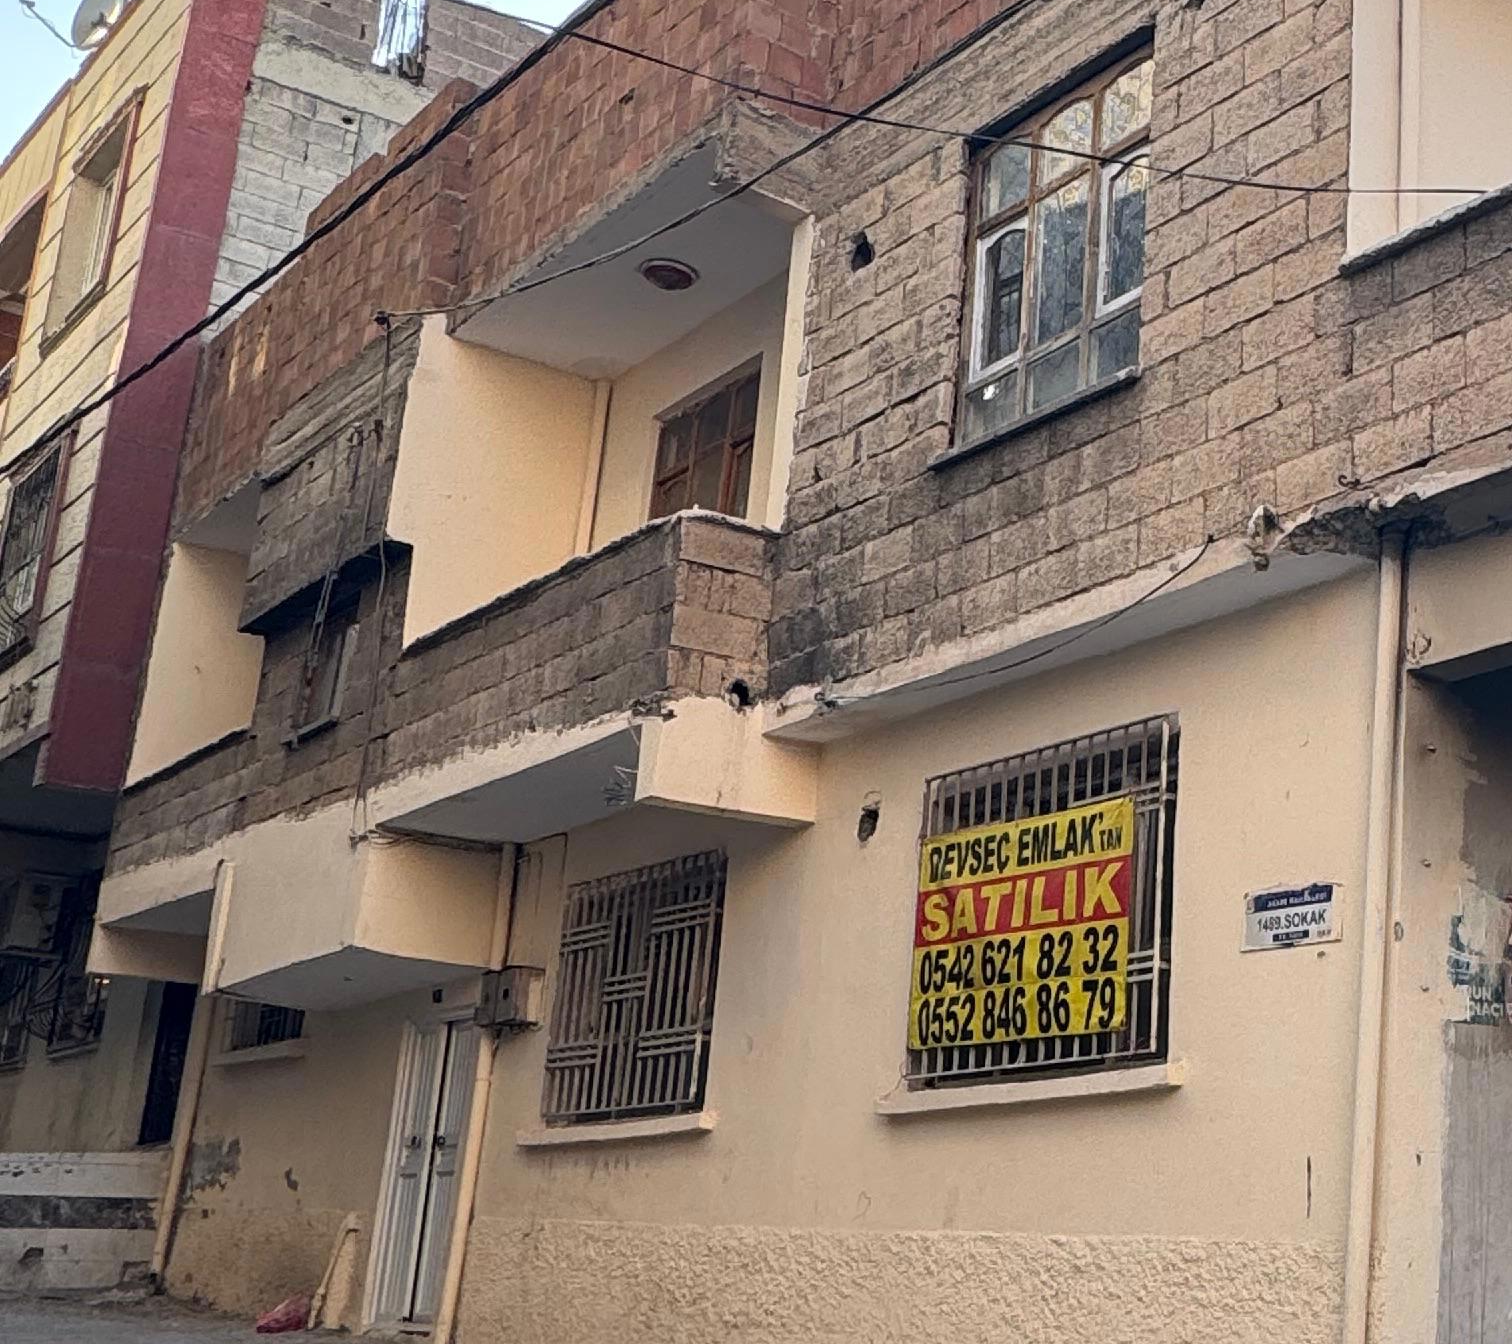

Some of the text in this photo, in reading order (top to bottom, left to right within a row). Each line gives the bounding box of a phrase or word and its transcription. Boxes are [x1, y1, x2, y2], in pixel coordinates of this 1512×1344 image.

[929, 828, 1010, 884] DEVSEÇ
[921, 861, 1123, 942] SATILIK
[919, 924, 1119, 995] 0542 621 82 32
[917, 976, 1116, 1045] 0552 846 86 79
